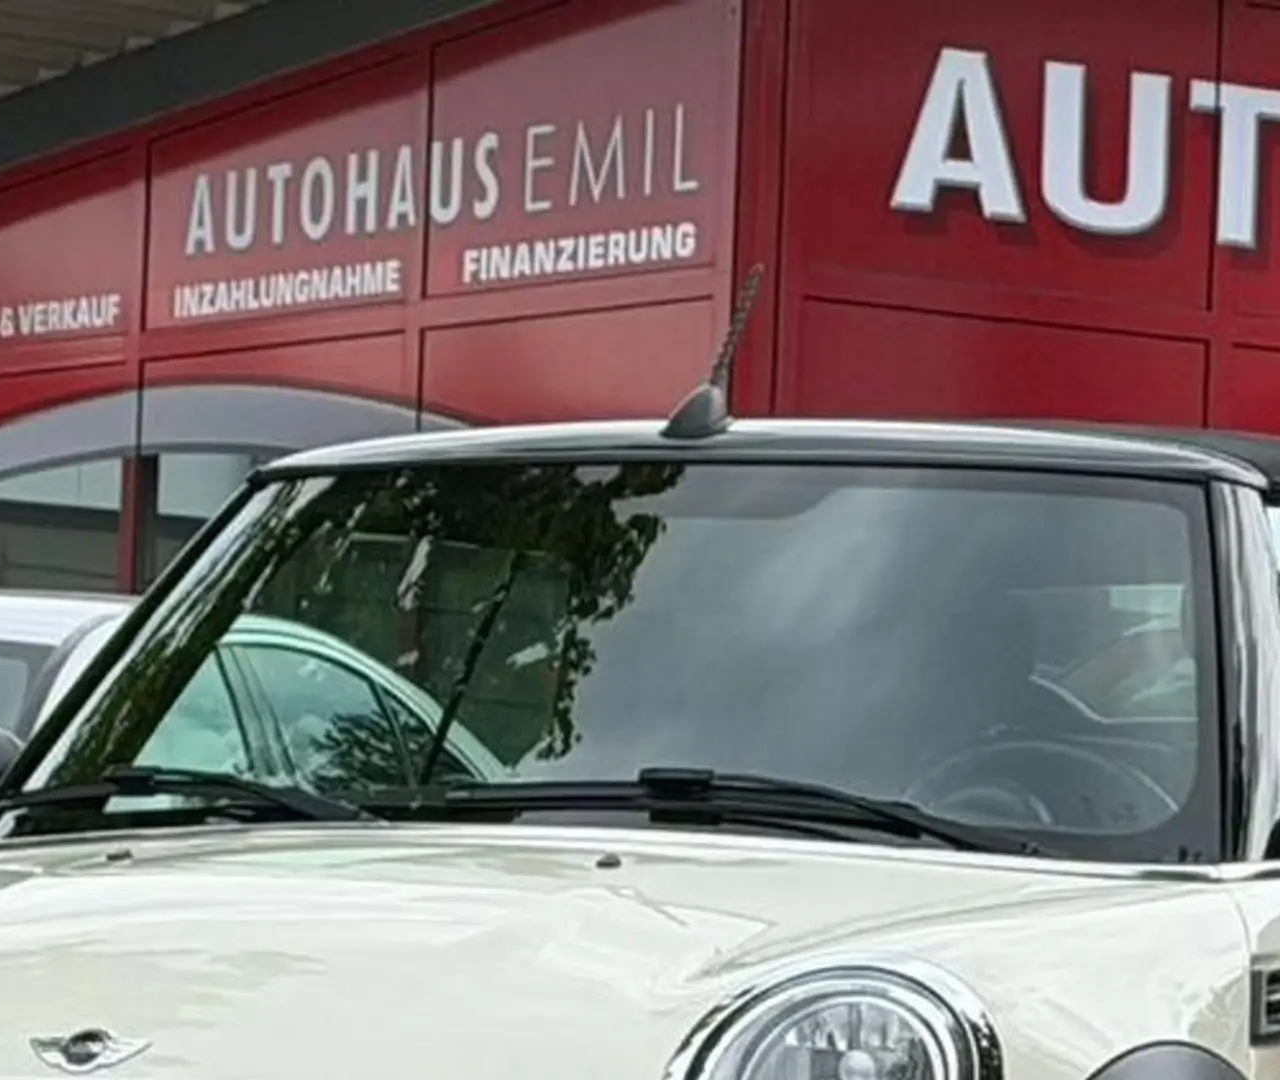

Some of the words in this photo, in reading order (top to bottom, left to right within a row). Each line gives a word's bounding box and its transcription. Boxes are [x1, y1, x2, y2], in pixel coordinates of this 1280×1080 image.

[185, 132, 499, 254] AUTOHAUS
[524, 104, 698, 213] EMIL
[462, 222, 697, 283] FINANZIERUNG
[18, 293, 121, 335] VERKAUF
[174, 259, 402, 318] INZAHLUNGNAHME
